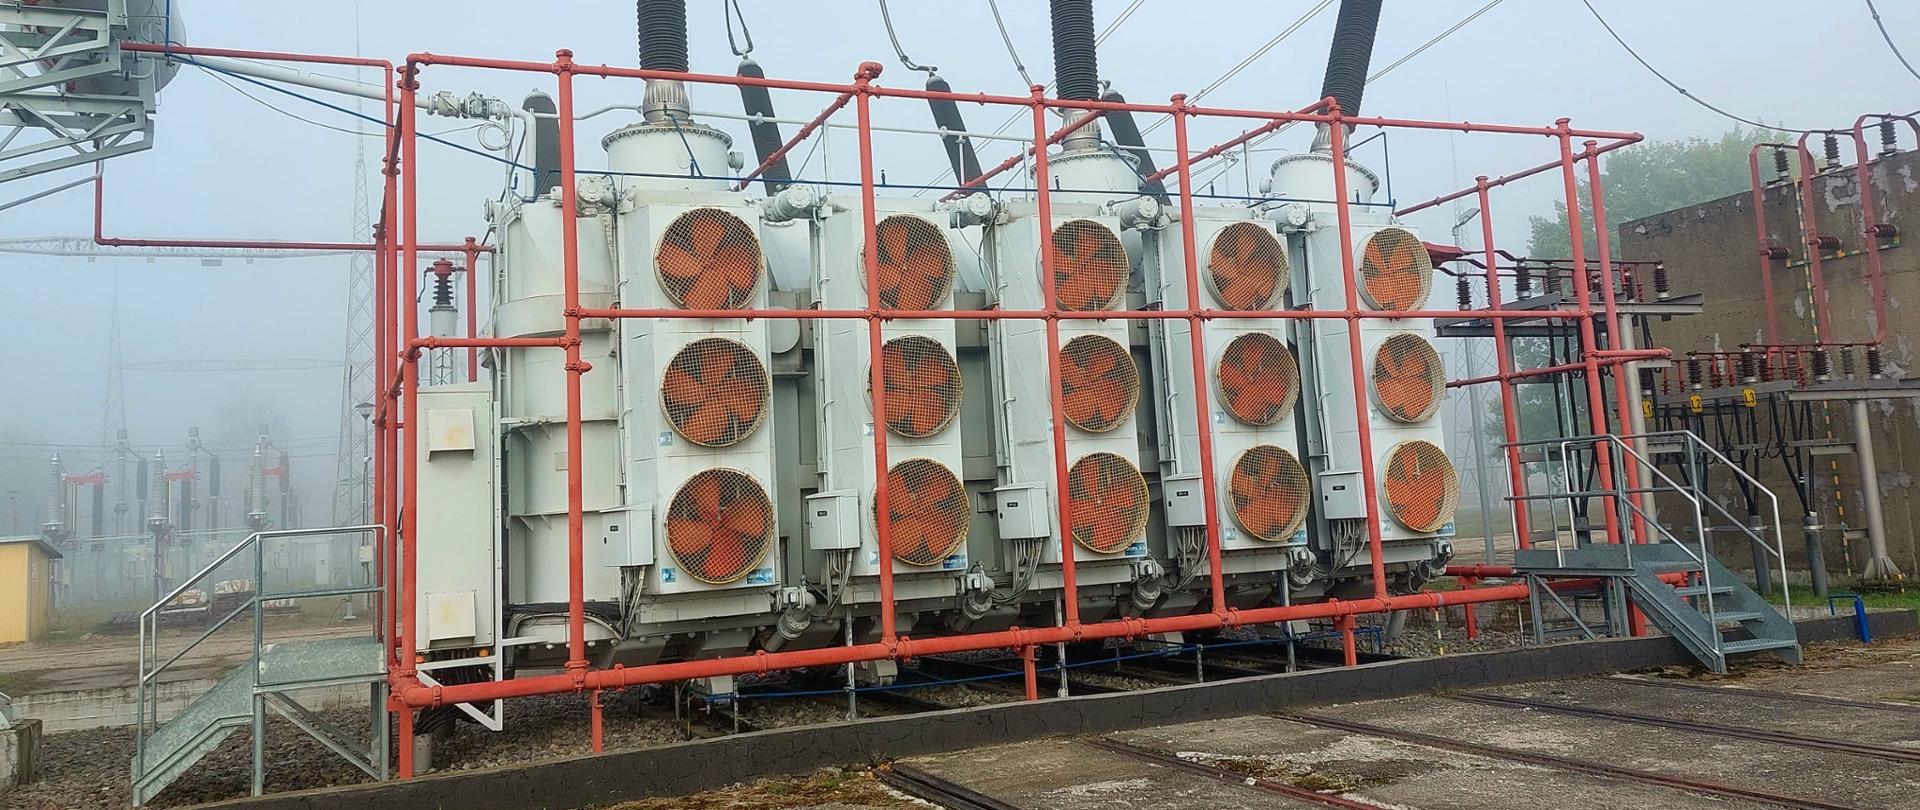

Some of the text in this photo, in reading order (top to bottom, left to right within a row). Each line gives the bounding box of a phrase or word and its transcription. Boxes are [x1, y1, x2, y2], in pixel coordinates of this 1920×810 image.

[1744, 392, 1755, 403] L3
[1691, 398, 1702, 409] L2
[1642, 404, 1651, 415] L1
